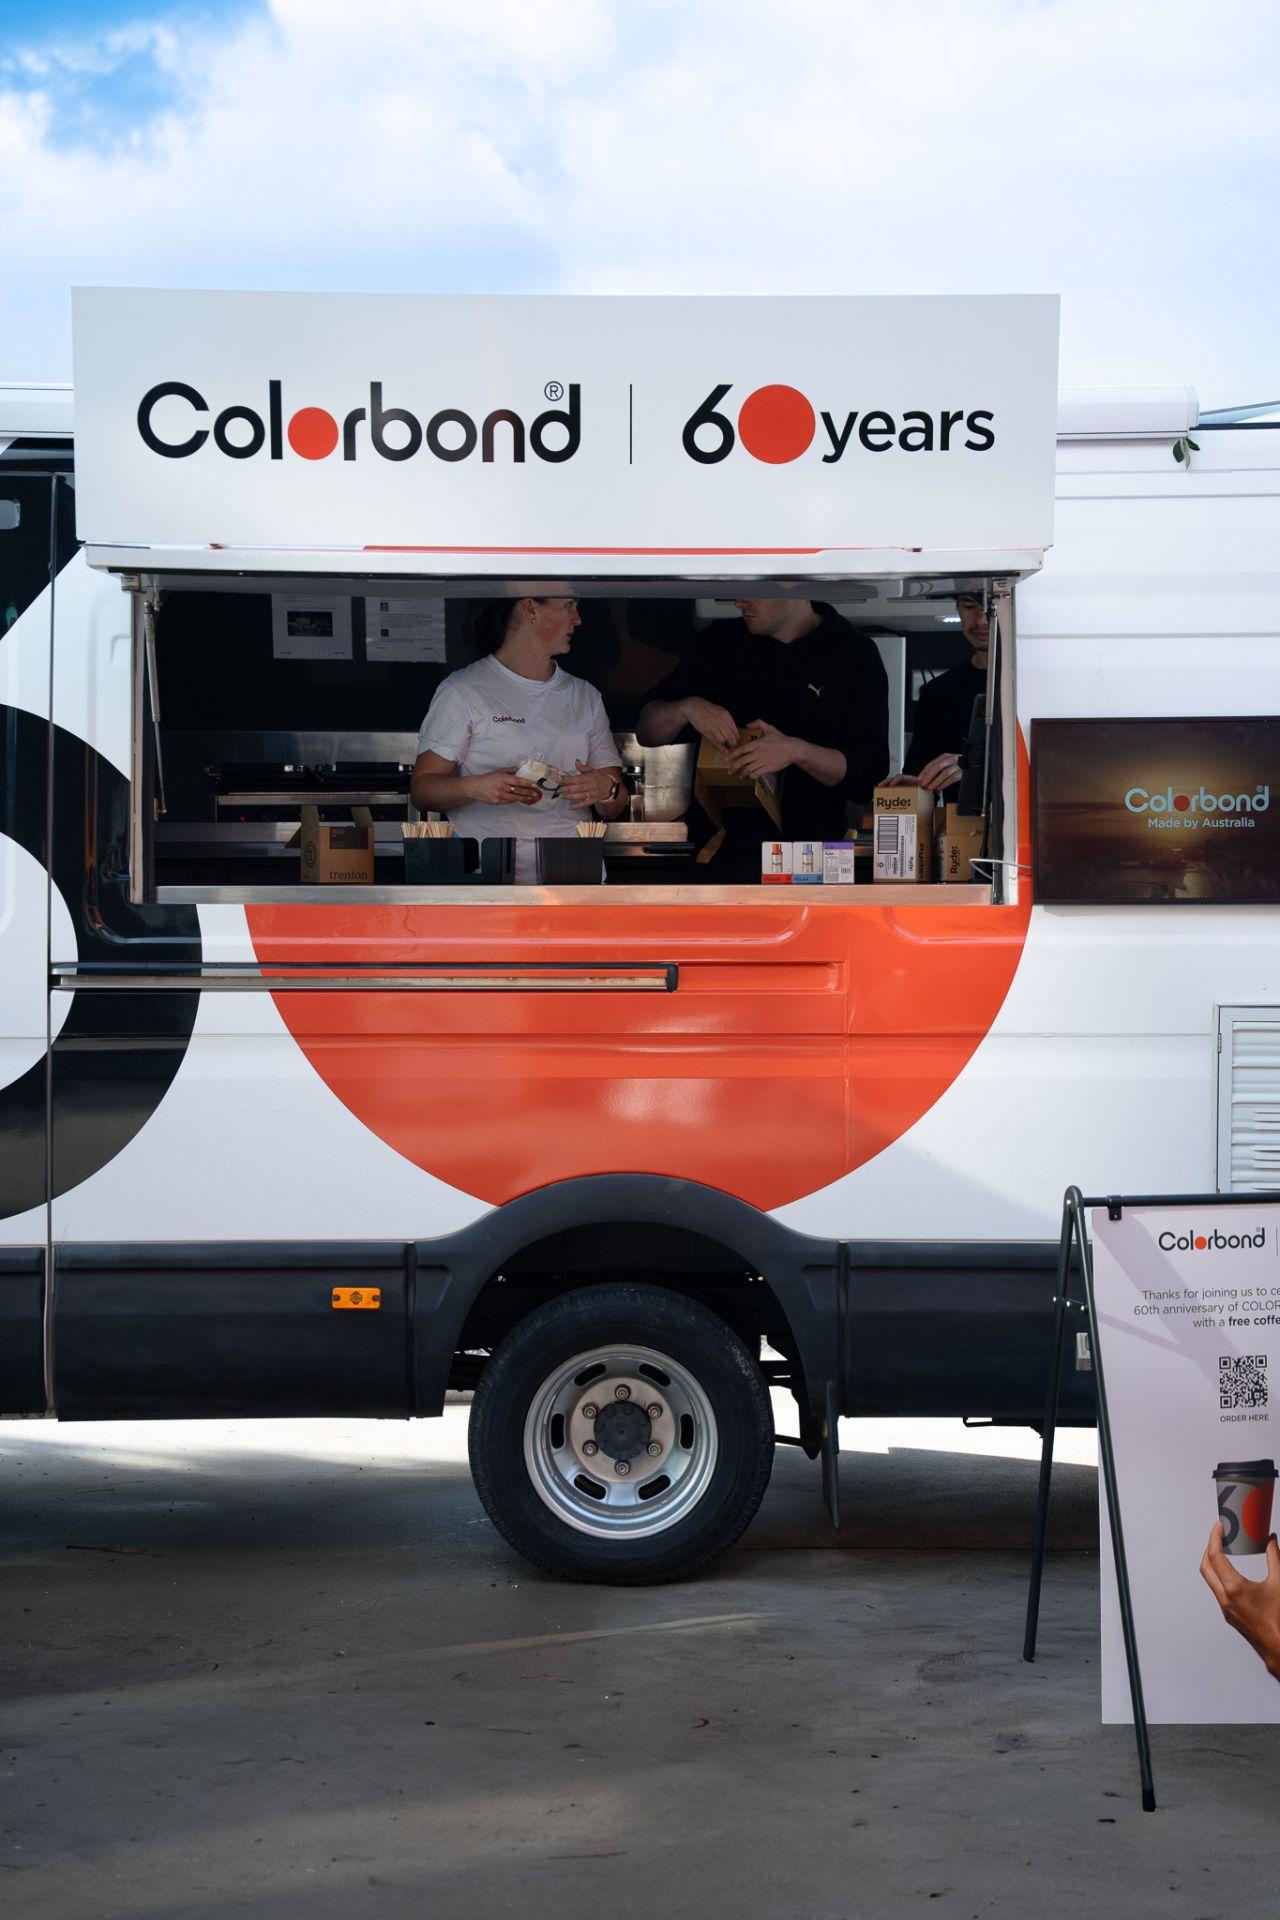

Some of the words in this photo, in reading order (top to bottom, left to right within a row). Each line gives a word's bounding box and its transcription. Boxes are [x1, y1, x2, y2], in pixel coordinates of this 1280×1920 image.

[1148, 818, 1181, 828] Made
[1183, 818, 1198, 830] by
[1202, 817, 1255, 828] Australia
[1142, 1289, 1181, 1301] Thanks
[1183, 1288, 1199, 1299] for
[1202, 1287, 1238, 1300] joining
[1240, 1288, 1253, 1297] us
[1256, 1287, 1268, 1297] to
[1133, 1304, 1160, 1316] 60th
[1162, 1302, 1225, 1315] anniversary
[1227, 1301, 1239, 1312] of
[1192, 1317, 1216, 1328] with
[1218, 1318, 1226, 1327] a
[1228, 1315, 1251, 1327] free
[1219, 1414, 1247, 1423] ORDER
[1248, 1413, 1269, 1422] HERE
